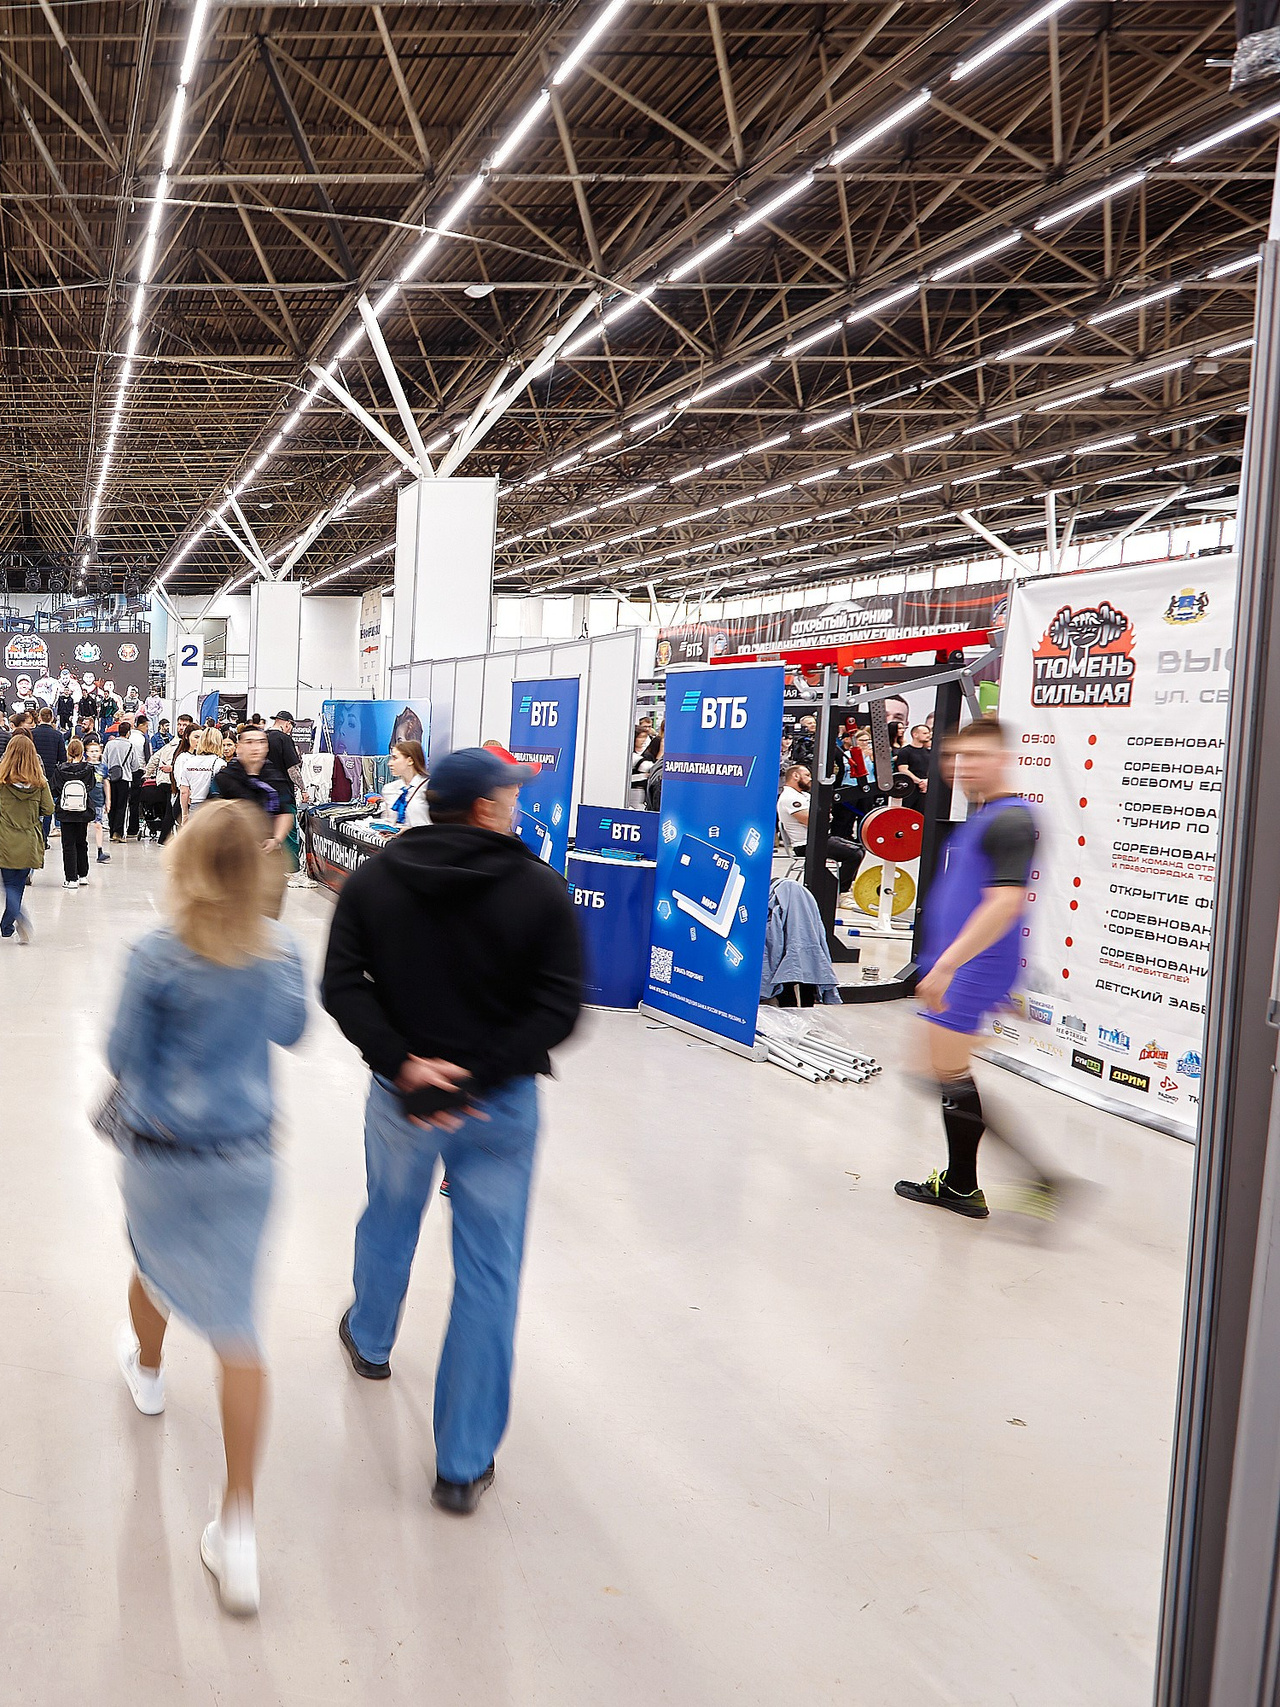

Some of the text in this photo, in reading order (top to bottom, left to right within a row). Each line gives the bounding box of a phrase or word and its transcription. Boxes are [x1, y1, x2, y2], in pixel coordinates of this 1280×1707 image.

[791, 608, 894, 635] ОТКРЫТЫЙ ТУРНИР
[181, 644, 199, 667] 2
[686, 642, 703, 657] ВТБ
[1034, 654, 1134, 679] ТЮМЕНЬ
[1033, 682, 1131, 704] СИЛЬНАЯ
[531, 701, 559, 727] ВТБ
[701, 696, 748, 729] ВТБ
[1021, 733, 1056, 744] 09:00
[664, 760, 743, 777] ЗАРПЛАТНАЯ КАРТА
[1018, 756, 1051, 767] 10:00
[1121, 776, 1193, 791] БОЕВОМУ
[612, 823, 641, 842] ВТБ
[1123, 816, 1210, 834] ТУРНИР ПО
[1113, 841, 1217, 863] СОРЕВНОВАН
[716, 857, 730, 870] ВТБ
[1141, 857, 1184, 869] КОМАНД
[1198, 873, 1215, 882] ТЮ
[574, 888, 605, 909] ВТБ
[1109, 883, 1190, 906] ОТКРЫТИЕ
[1110, 909, 1212, 936] СОРЕВНОВАН
[1108, 923, 1210, 952] СОРЕВНОВАН
[1127, 964, 1190, 984] ЛЮБИТЕЛЕЙ
[1095, 978, 1163, 1004] ДЕТСКИЙ
[1111, 1070, 1147, 1088] ДРИМ
